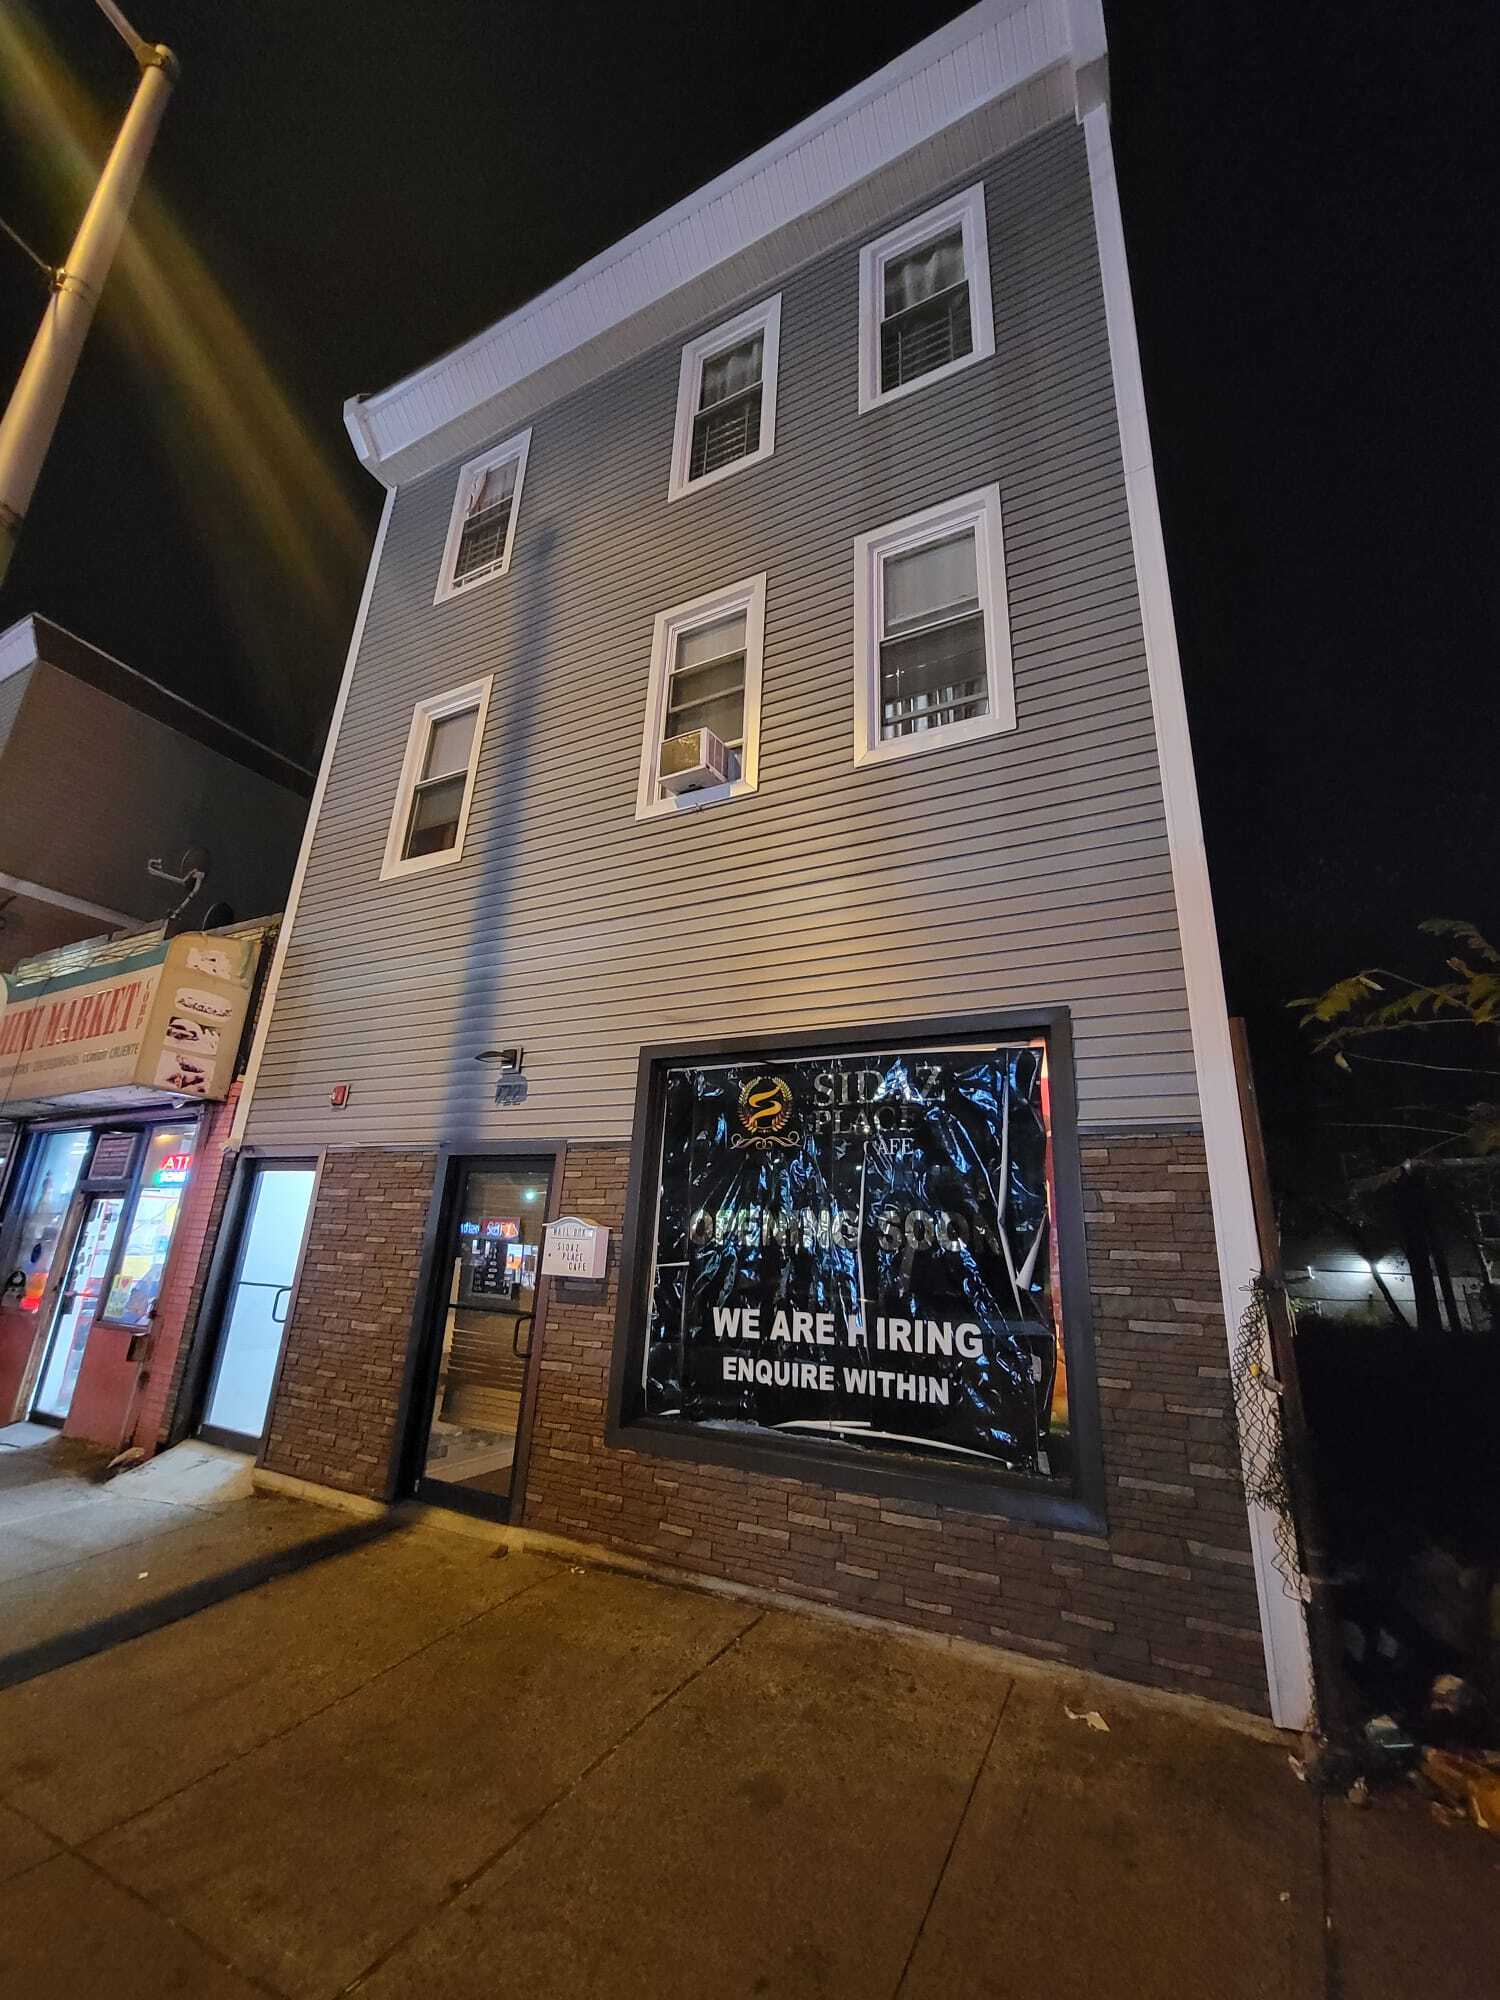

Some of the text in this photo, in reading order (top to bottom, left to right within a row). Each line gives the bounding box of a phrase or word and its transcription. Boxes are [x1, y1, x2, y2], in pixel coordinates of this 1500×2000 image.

[39, 980, 142, 1049] MARKET
[814, 1105, 915, 1134] PLACE
[864, 1137, 915, 1156] AFE
[712, 1307, 760, 1339] WE
[770, 1310, 835, 1346] ARE
[722, 1356, 949, 1406] ENQUIRE WITHIN
